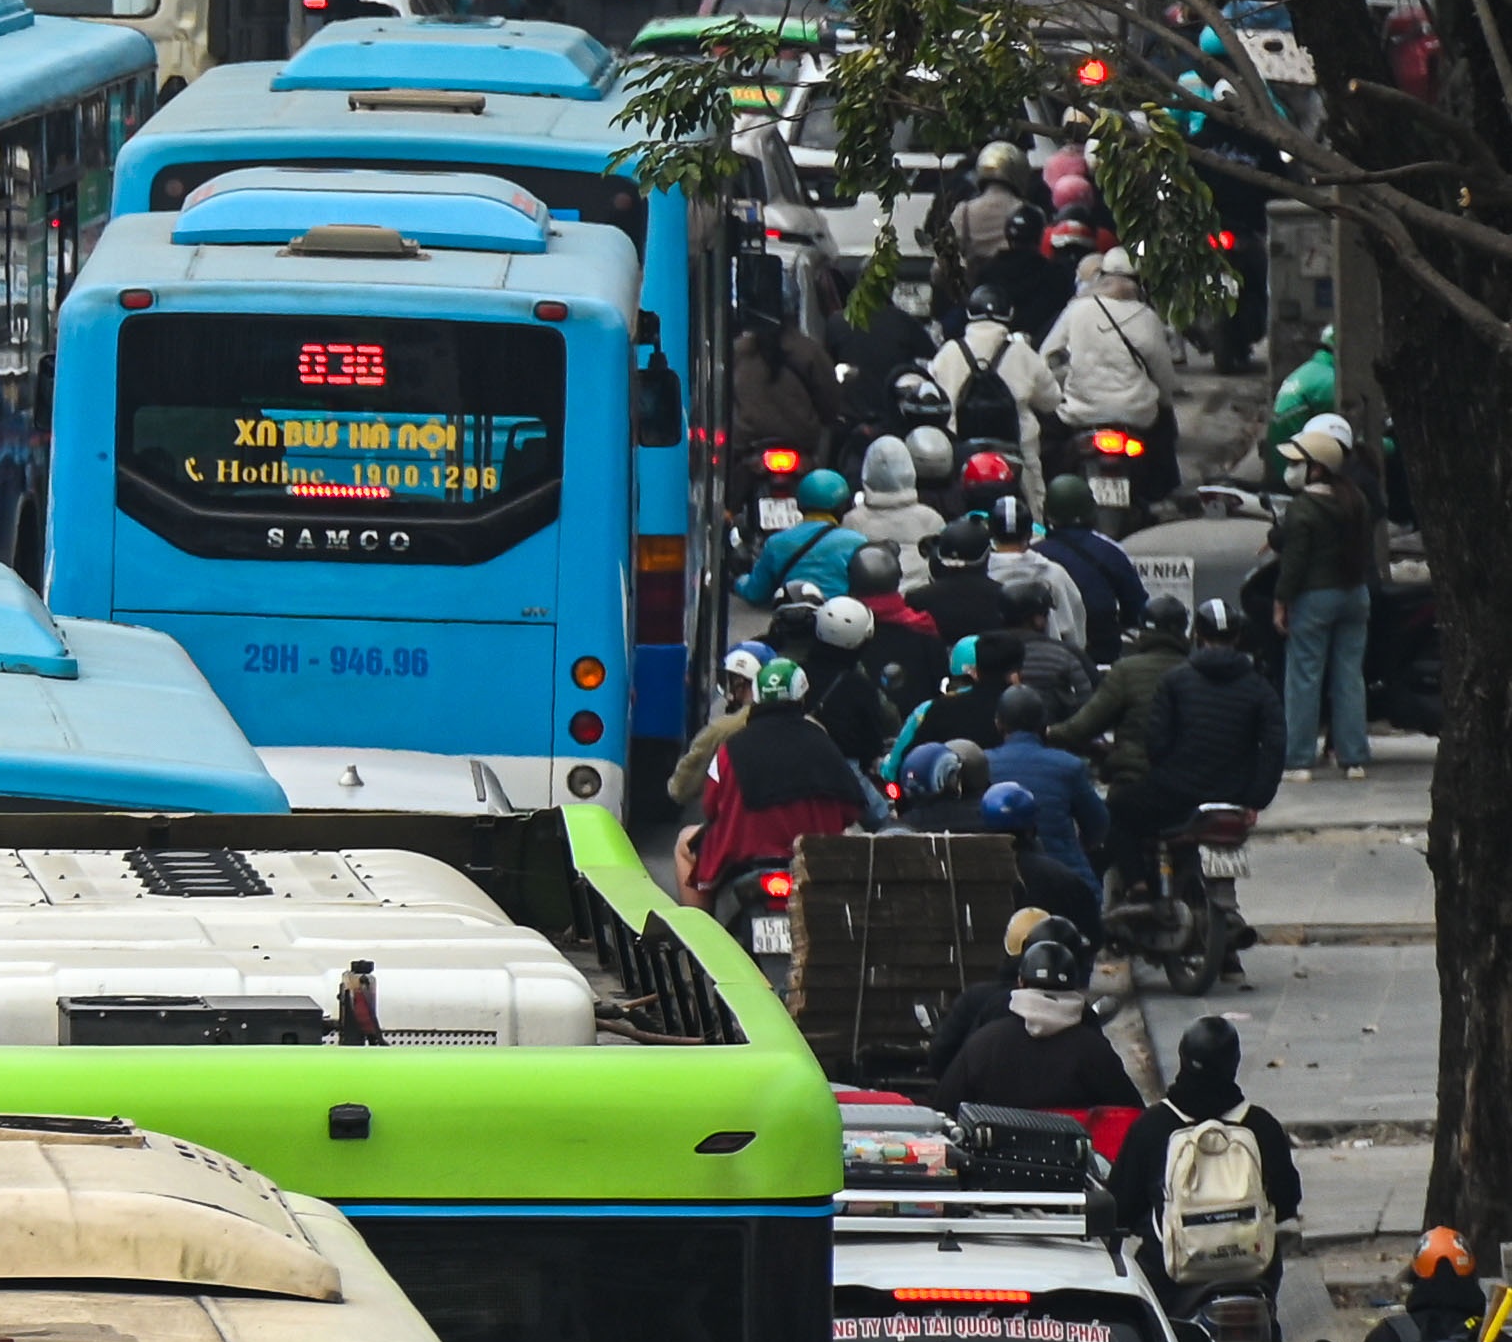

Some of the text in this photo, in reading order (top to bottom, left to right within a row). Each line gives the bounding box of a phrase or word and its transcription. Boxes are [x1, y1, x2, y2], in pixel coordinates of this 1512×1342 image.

[283, 420, 338, 449] BUS
[349, 417, 389, 451] HÀ
[398, 417, 456, 459] NỘI
[267, 527, 410, 551] SAMCO
[244, 644, 429, 677] 29H 946.96
[859, 1316, 882, 1339] TY
[885, 1312, 920, 1342] VẬN
[923, 1311, 951, 1339] TẢI
[954, 1310, 1002, 1339] QUỐC
[1004, 1310, 1026, 1339] TẾ
[1028, 1315, 1064, 1341] ĐỨC
